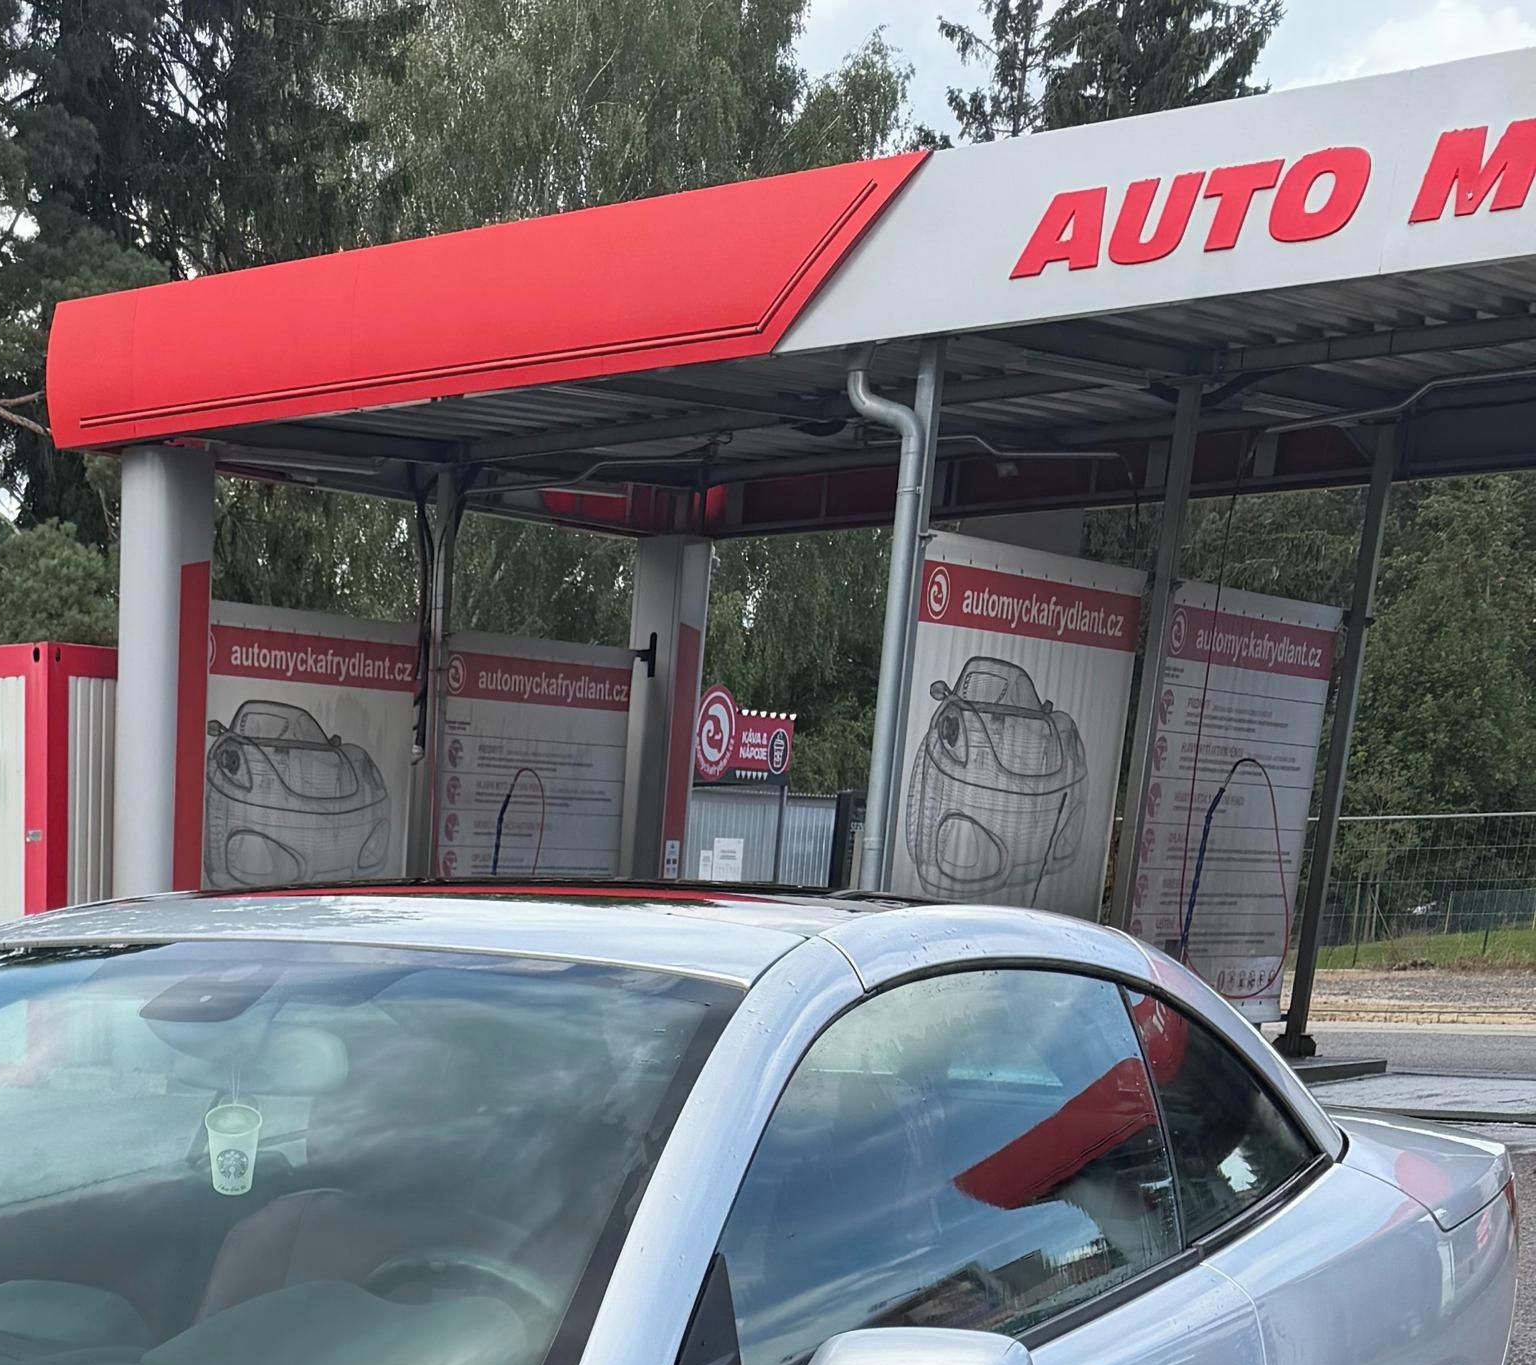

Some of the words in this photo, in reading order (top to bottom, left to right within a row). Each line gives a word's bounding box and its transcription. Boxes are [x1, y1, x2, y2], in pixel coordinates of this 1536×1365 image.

[1009, 145, 1372, 280] AUTO
[962, 588, 1124, 638] automyckafrydlant.cz
[231, 643, 412, 682] automyckafrydlant.cz
[1195, 627, 1323, 668] automyckafrydlant.cz
[478, 669, 629, 702] automyckafrydlant.cz
[739, 743, 768, 761] NÁPOJE
[742, 728, 761, 745] KÁVA
